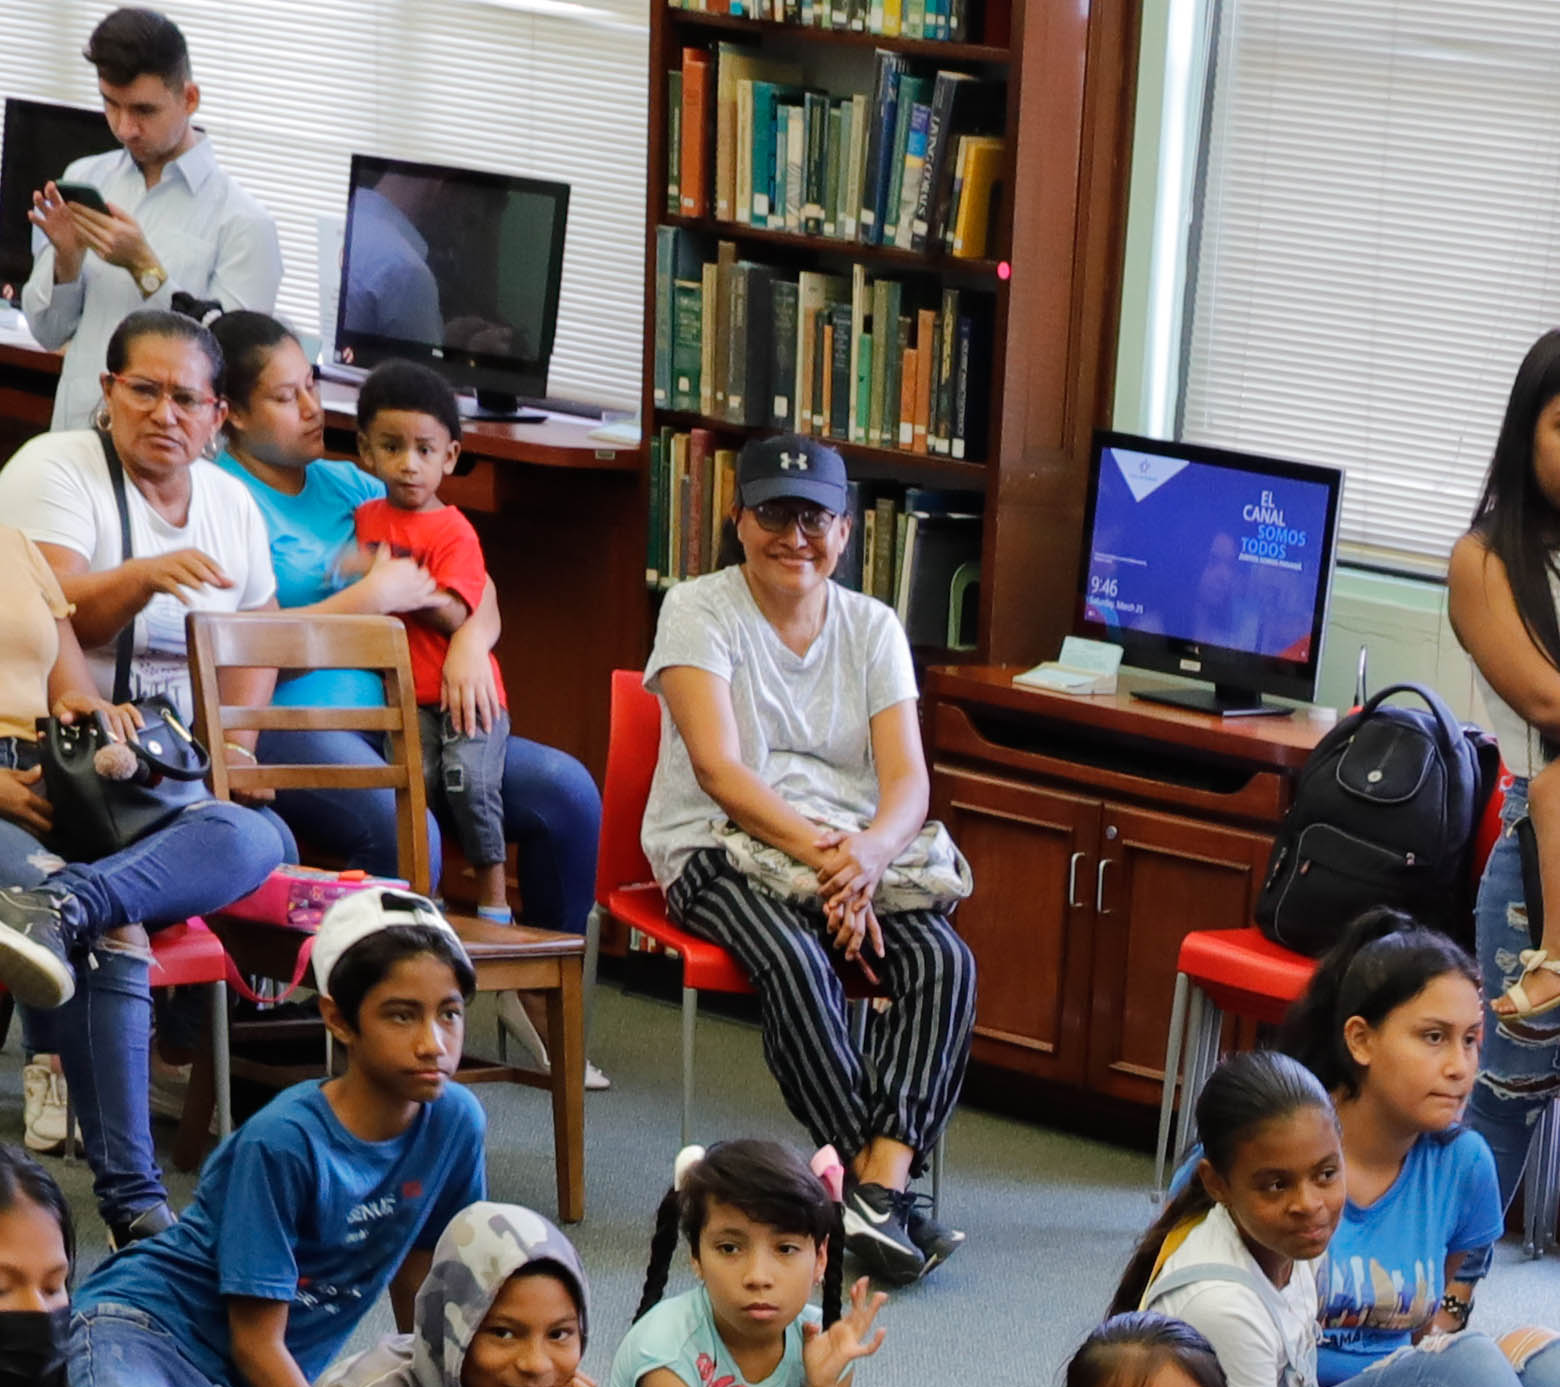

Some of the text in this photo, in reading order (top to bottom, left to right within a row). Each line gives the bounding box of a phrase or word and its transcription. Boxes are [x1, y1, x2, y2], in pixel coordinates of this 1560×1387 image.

[1260, 490, 1275, 508] EL
[1243, 504, 1286, 527] CANAL
[1258, 526, 1306, 547] SOMOS
[1240, 537, 1287, 560] TODOS
[1091, 575, 1118, 597] 9:46
